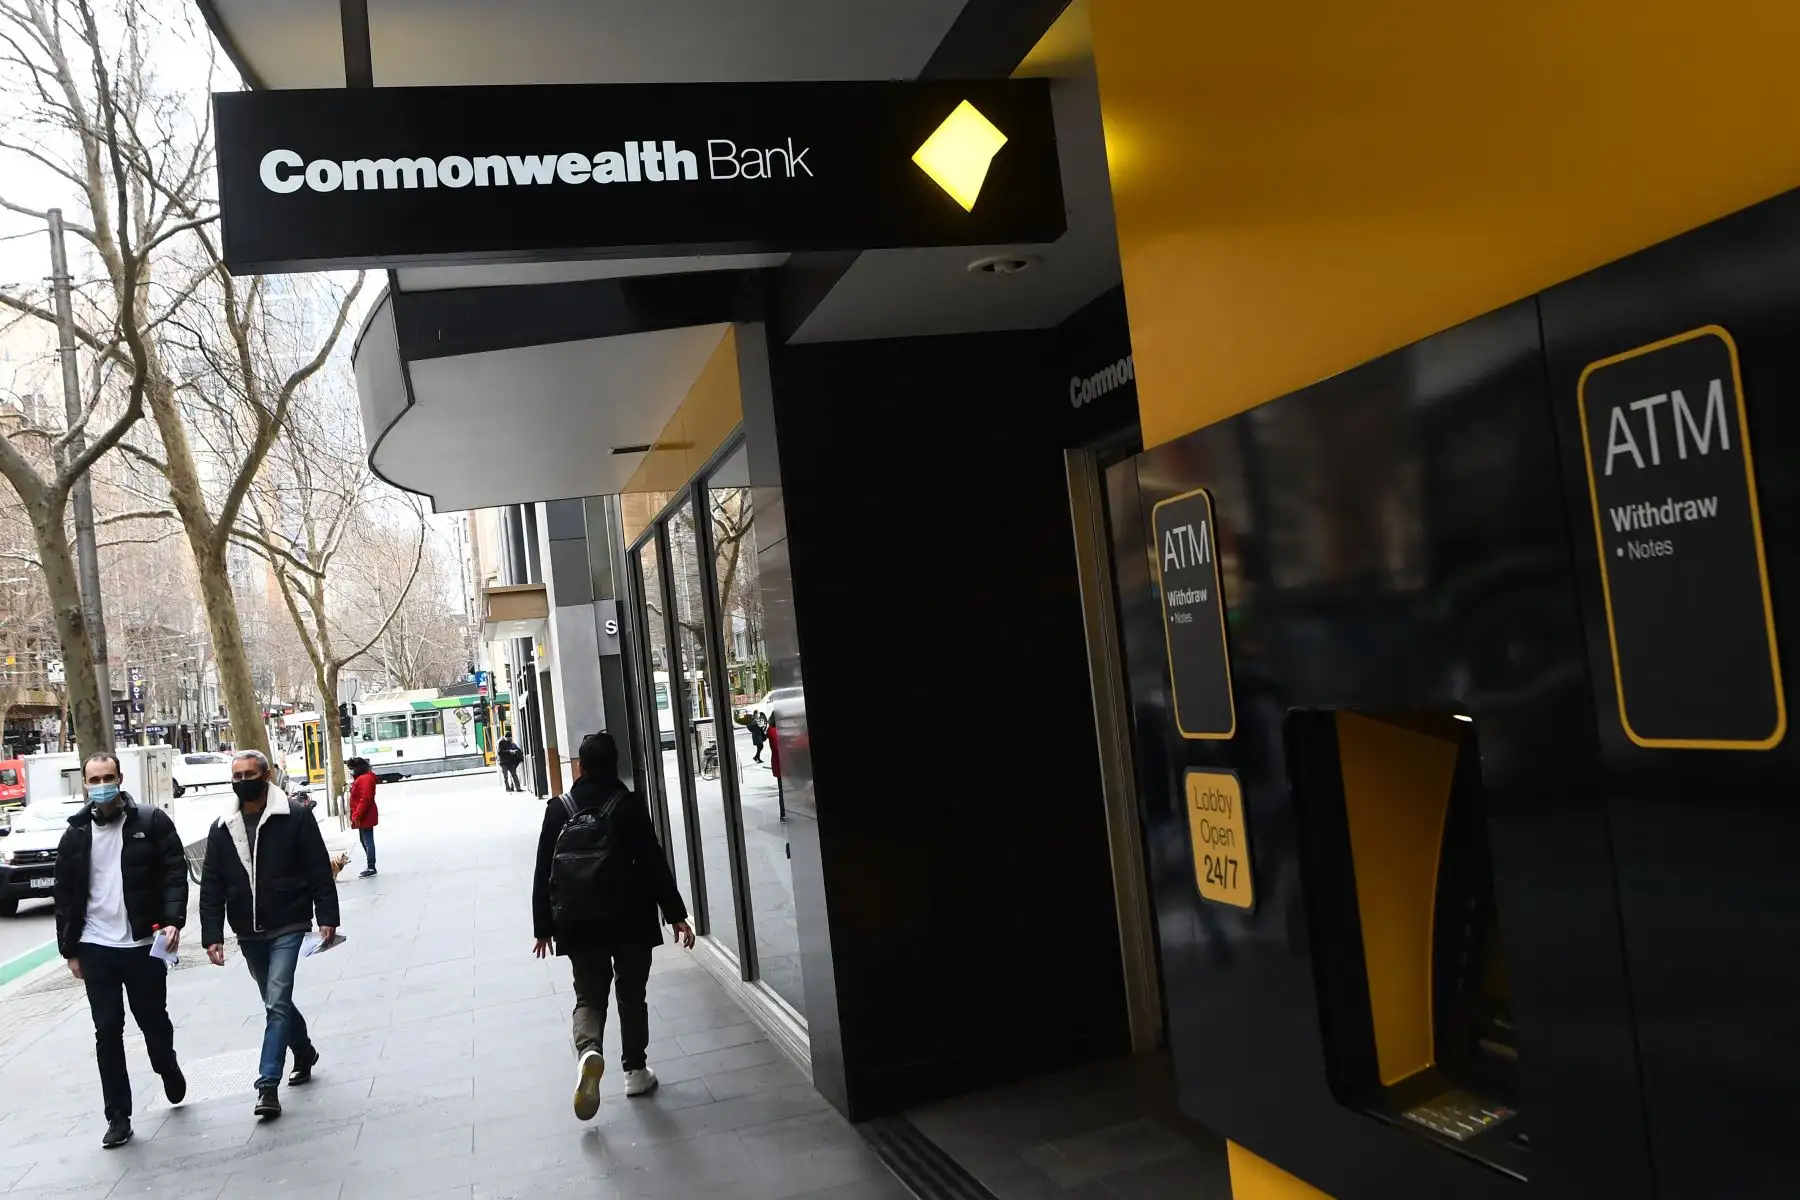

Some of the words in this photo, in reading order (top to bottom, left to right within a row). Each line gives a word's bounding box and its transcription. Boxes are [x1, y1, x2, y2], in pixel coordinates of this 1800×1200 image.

[259, 140, 698, 194] Commonwealth
[707, 137, 813, 181] Bank
[1604, 378, 1730, 476] ATM
[1609, 496, 1718, 533] Withdraw
[1164, 520, 1210, 572] ATM
[1627, 539, 1674, 561] Notes
[1167, 587, 1207, 607] Withdraw
[1174, 612, 1192, 624] Notes
[131, 668, 141, 712] NOOTL
[1193, 785, 1233, 819] Lobby
[1200, 818, 1236, 849] Open
[1204, 854, 1238, 889] 24/7
